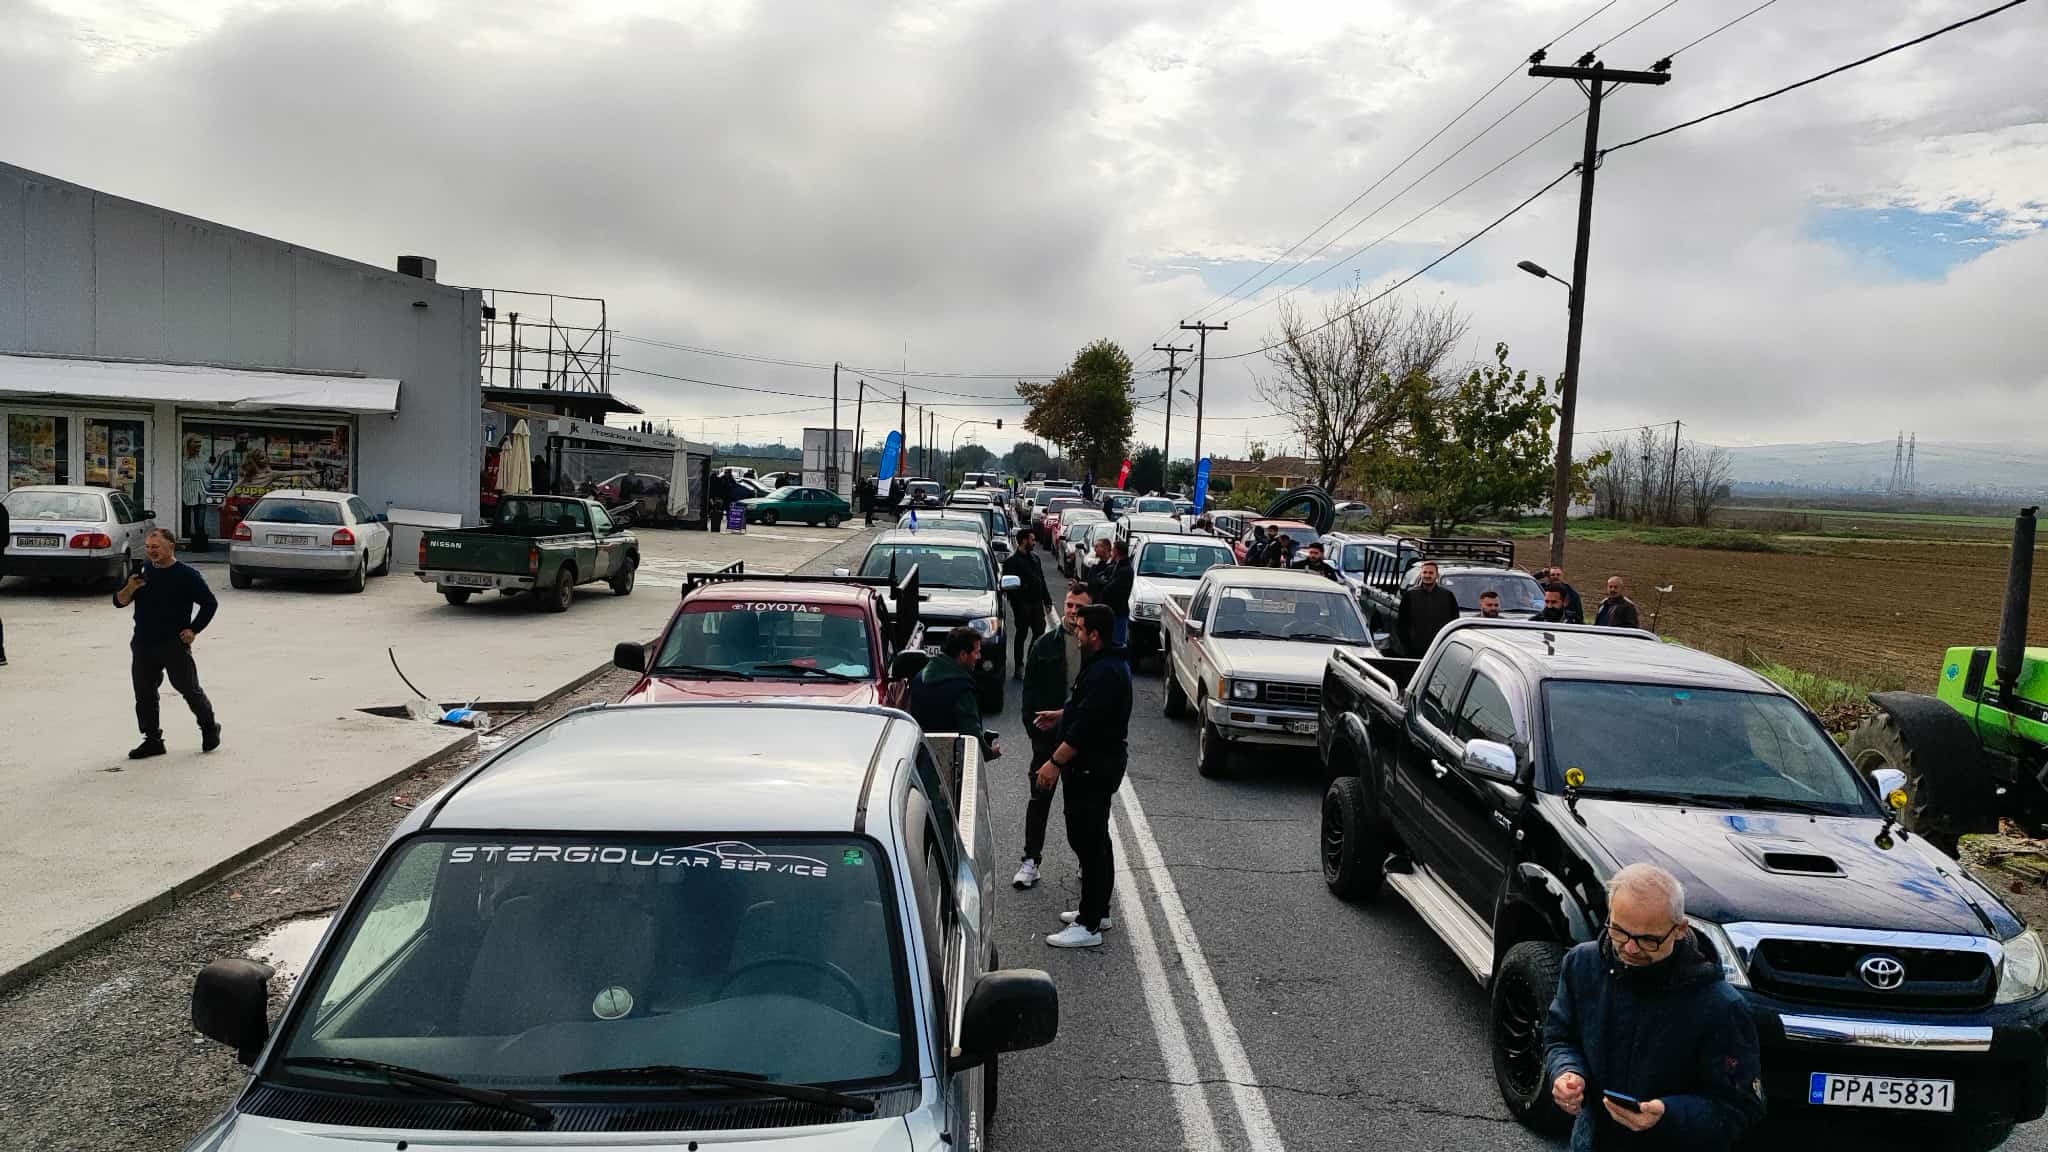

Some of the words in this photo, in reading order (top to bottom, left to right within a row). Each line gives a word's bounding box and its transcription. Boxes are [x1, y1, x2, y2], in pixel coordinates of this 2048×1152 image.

[430, 540, 462, 549] NISSAN
[744, 602, 808, 613] TOYOTA
[658, 855, 710, 868] CAR
